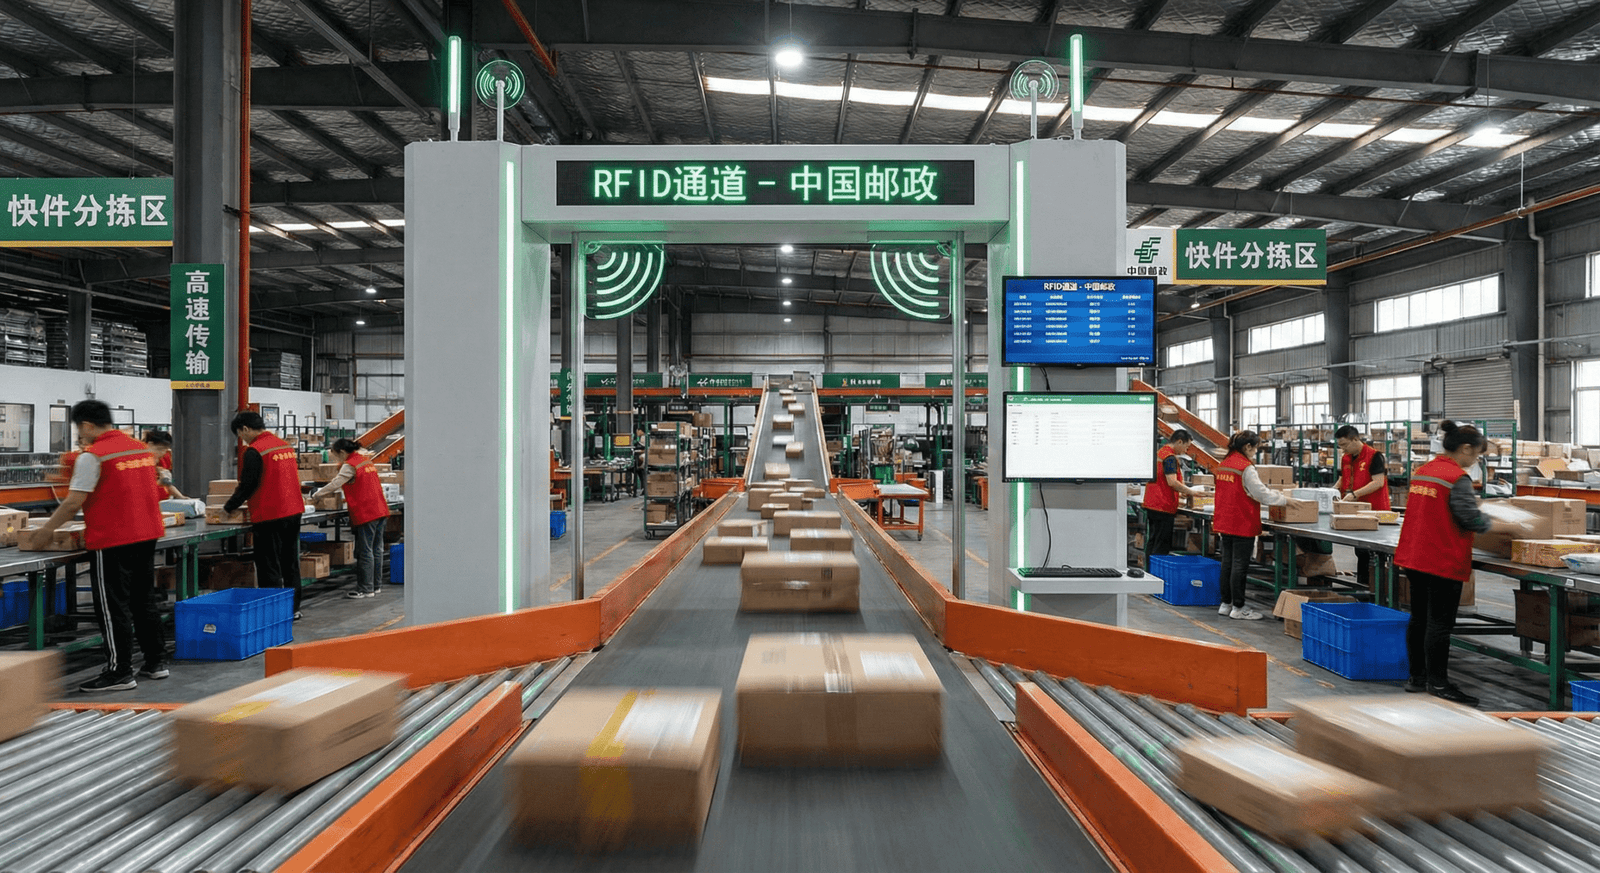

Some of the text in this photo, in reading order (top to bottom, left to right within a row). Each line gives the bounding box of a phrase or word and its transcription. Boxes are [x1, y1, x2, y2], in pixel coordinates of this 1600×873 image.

[593, 165, 747, 202] RFID通道
[791, 165, 938, 202] 中国邮政
[7, 193, 168, 228] 快件分拣区
[1127, 265, 1168, 276] 中国邮政
[1185, 241, 1318, 270] 快件分拣区
[185, 270, 210, 375] 高速传输
